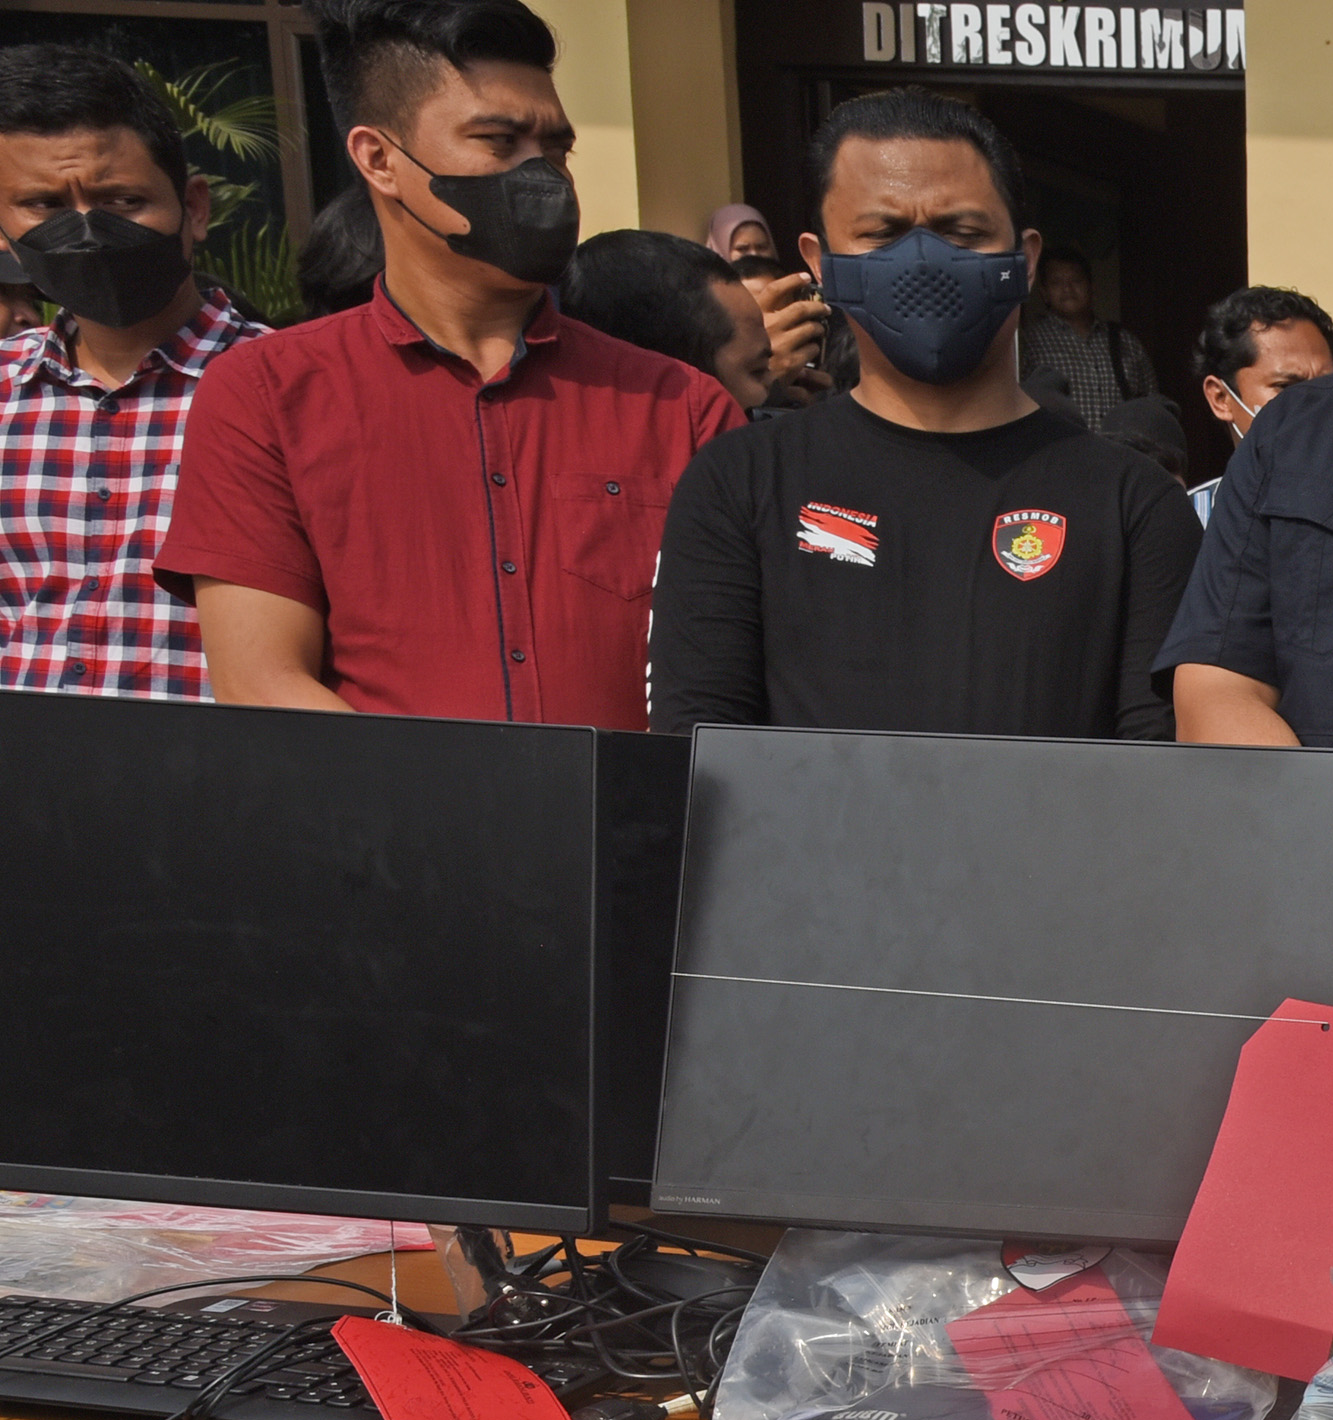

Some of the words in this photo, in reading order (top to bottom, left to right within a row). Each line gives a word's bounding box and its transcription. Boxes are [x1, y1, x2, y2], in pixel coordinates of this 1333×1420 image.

[806, 502, 878, 528] INDONESIA
[1003, 512, 1060, 525] RESMOB
[684, 1196, 720, 1205] HARMAN
